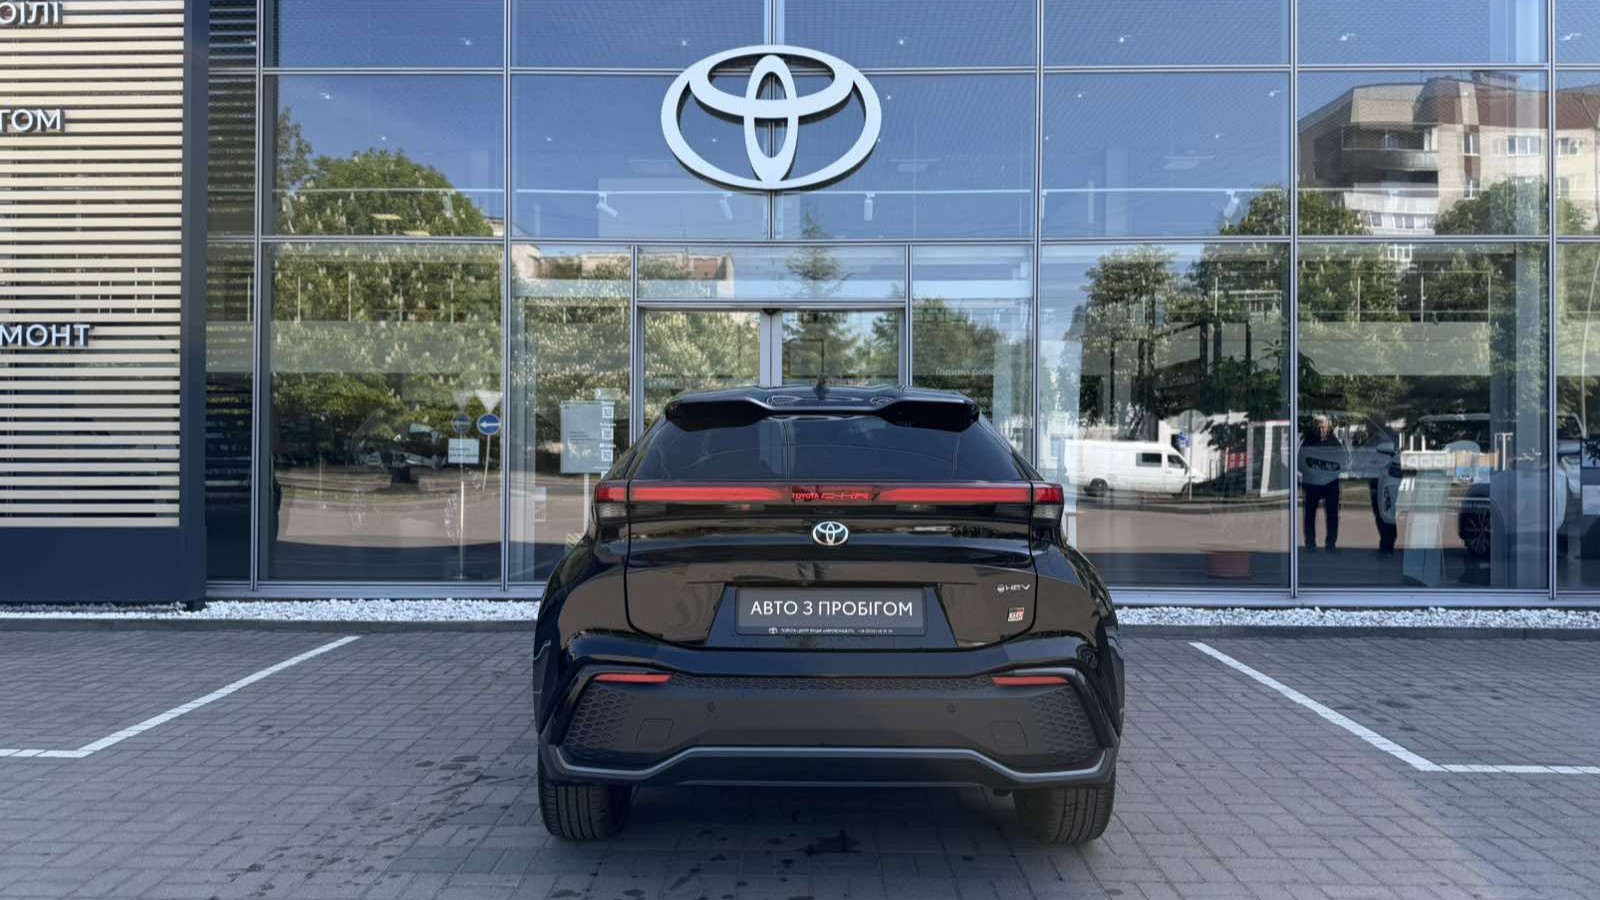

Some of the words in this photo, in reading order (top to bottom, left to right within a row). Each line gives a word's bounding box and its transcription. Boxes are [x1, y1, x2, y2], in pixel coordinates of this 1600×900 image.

[0, 324, 91, 347] МОНТ
[791, 491, 819, 500] TOYOTA
[750, 600, 799, 616] АВТО
[818, 601, 913, 616] ПРОБІГОМ
